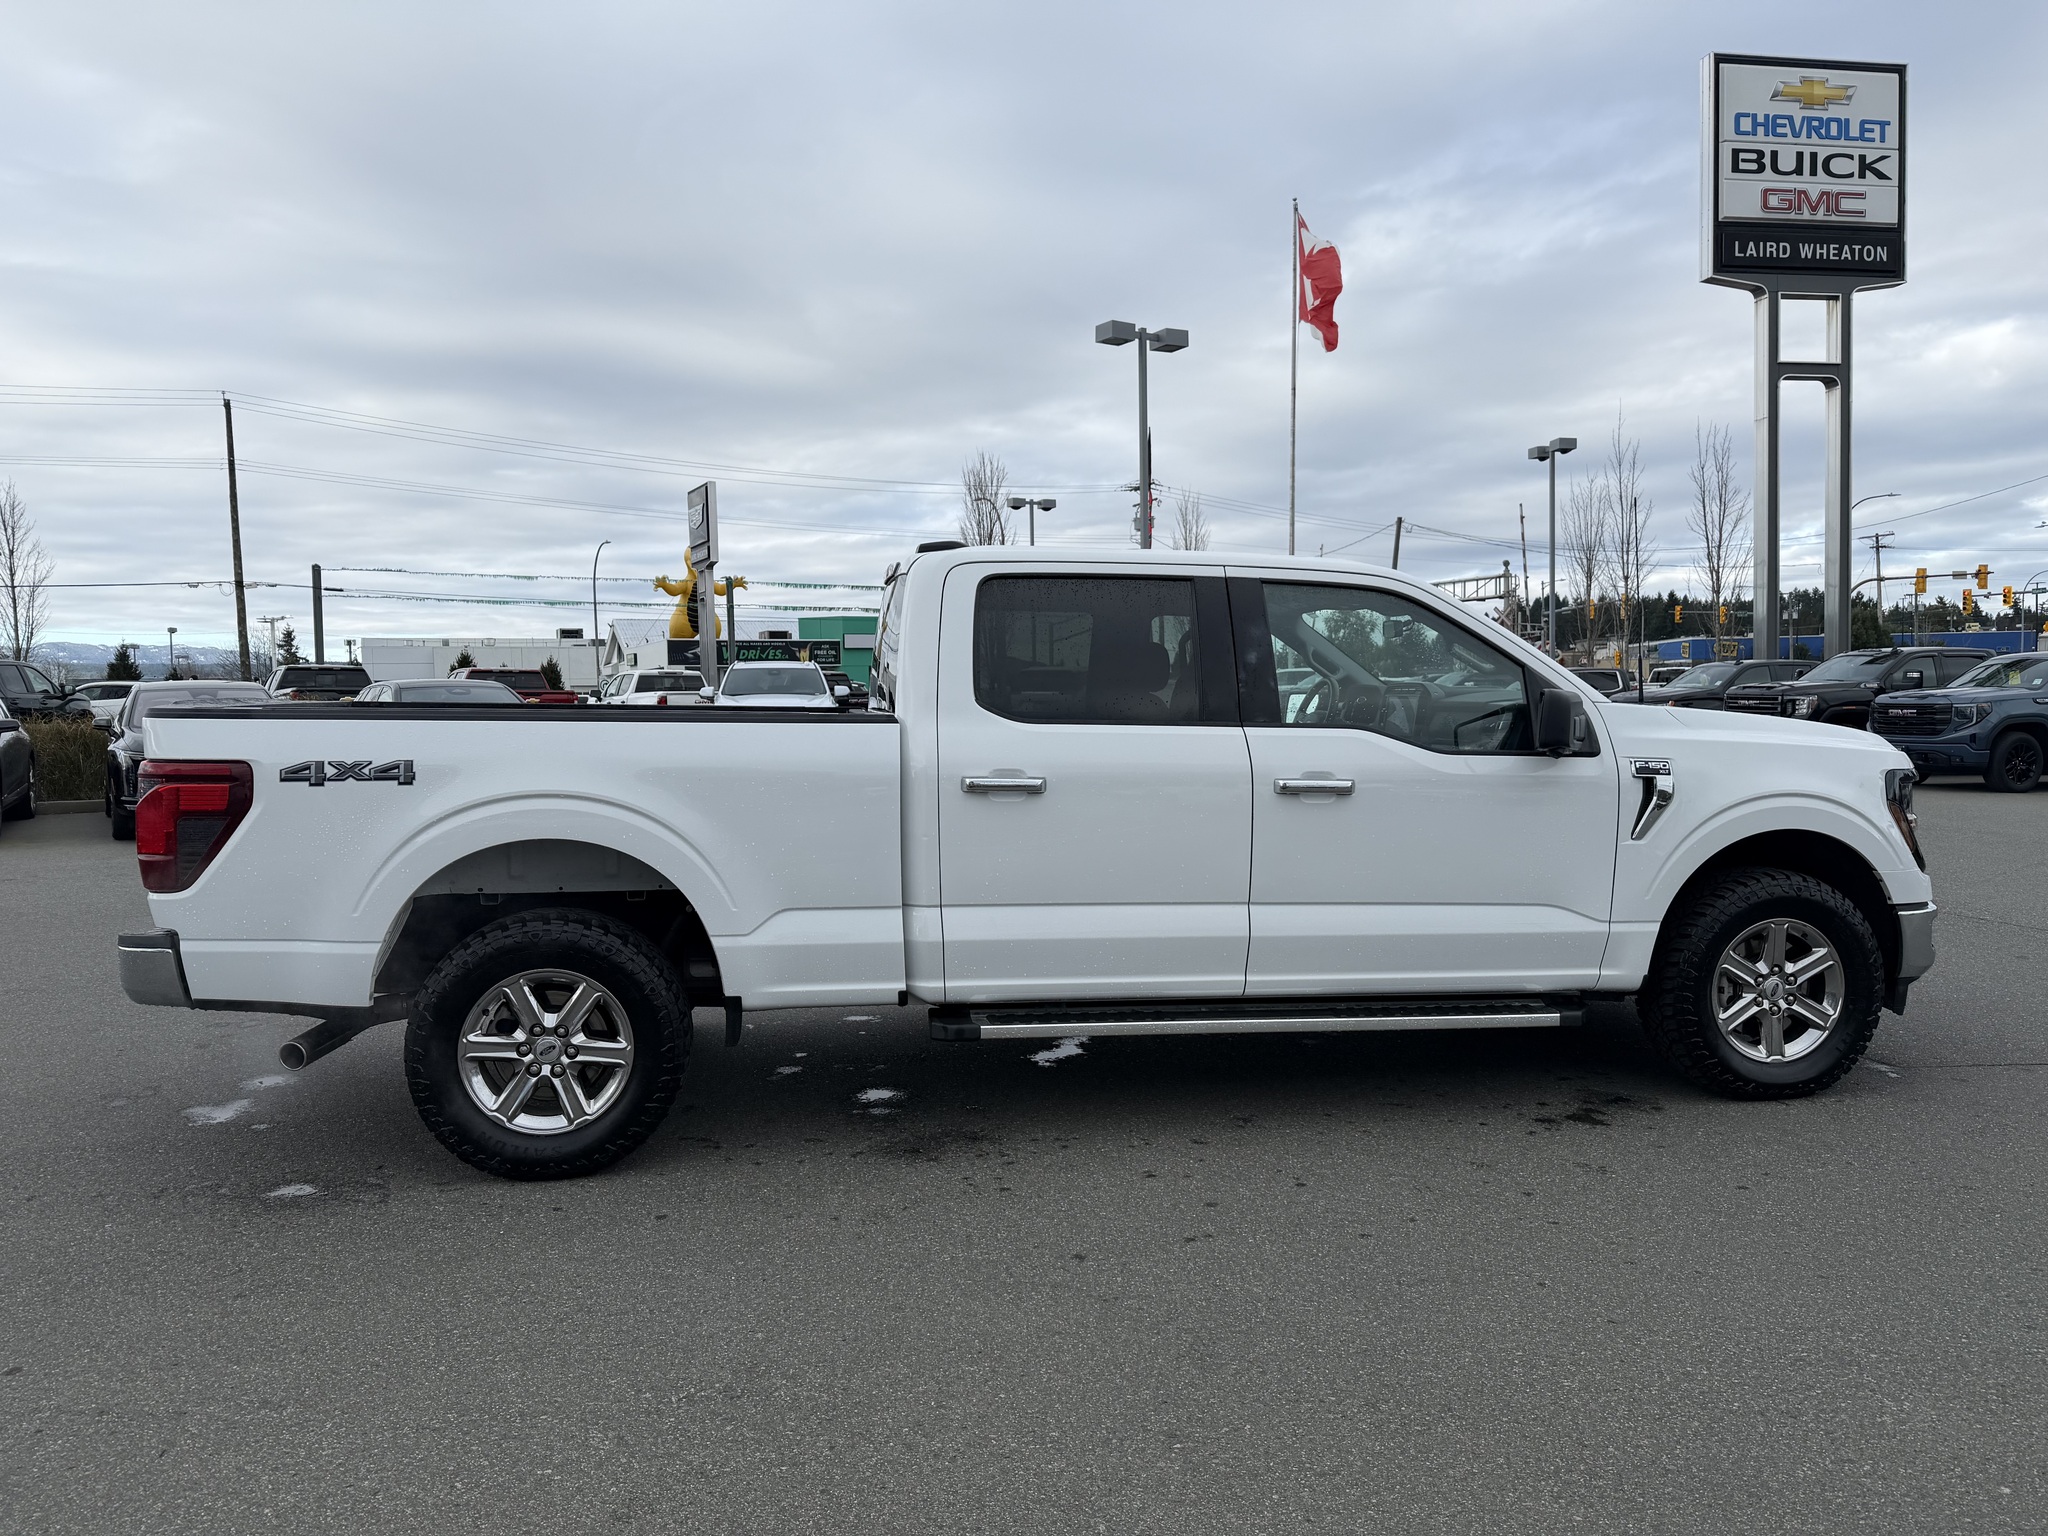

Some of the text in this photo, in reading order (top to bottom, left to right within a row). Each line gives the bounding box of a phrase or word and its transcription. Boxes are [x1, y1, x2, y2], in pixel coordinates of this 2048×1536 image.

[1733, 112, 1891, 143] CHEVROLET
[1730, 148, 1893, 181] BUICK
[1760, 186, 1867, 217] GMC
[1734, 240, 1888, 262] LAIRD WHEATON
[1888, 709, 1917, 717] GMC
[1635, 761, 1669, 769] F-150
